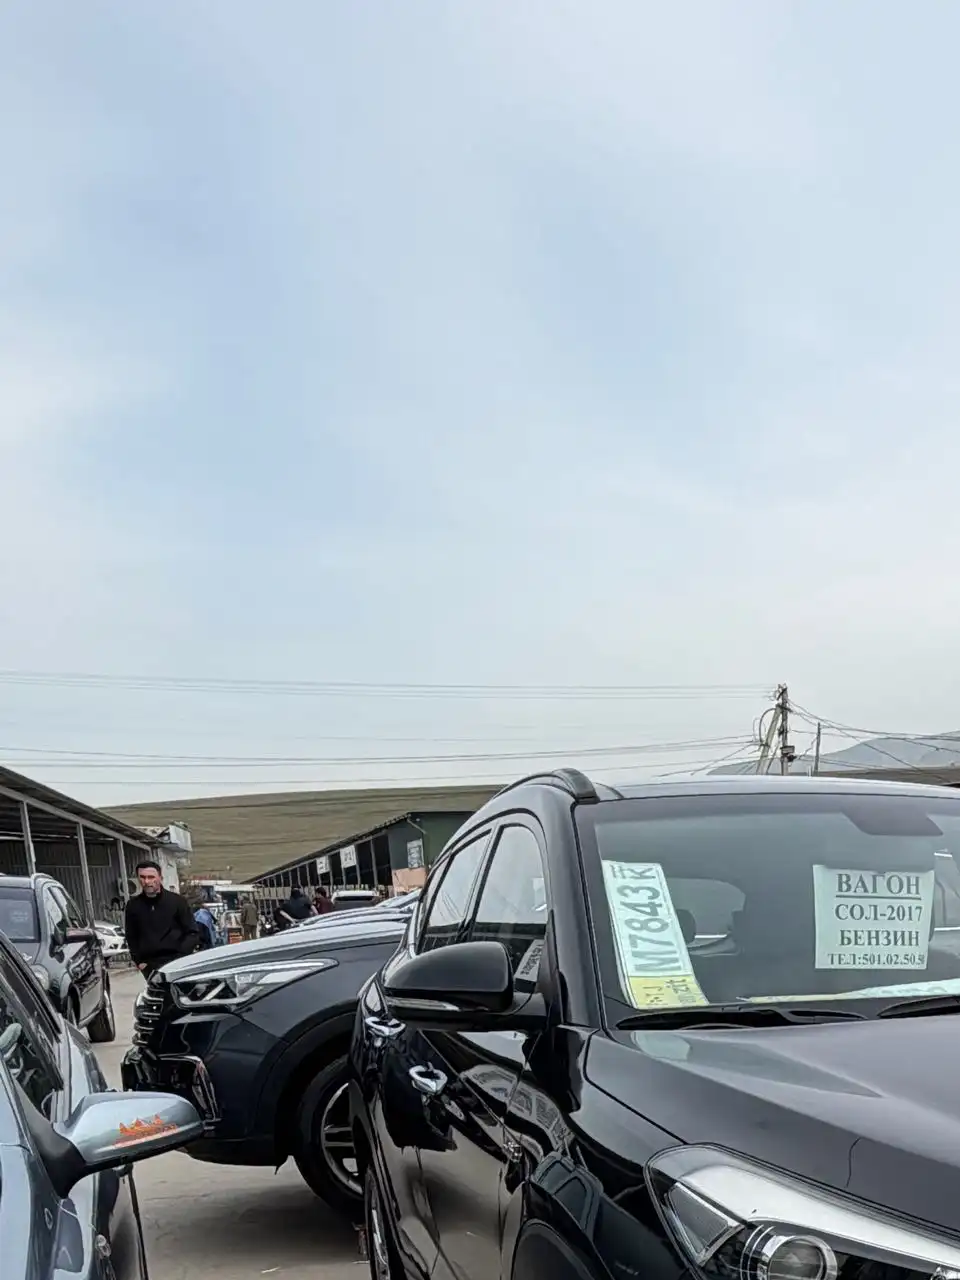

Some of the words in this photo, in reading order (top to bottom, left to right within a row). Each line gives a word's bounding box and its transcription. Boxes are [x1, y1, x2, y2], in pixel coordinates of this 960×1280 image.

[836, 873, 920, 895] ВАГОН
[835, 903, 923, 922] СОЛ-2017
[617, 885, 682, 972] M7843
[839, 929, 920, 947] БЕНЗИН
